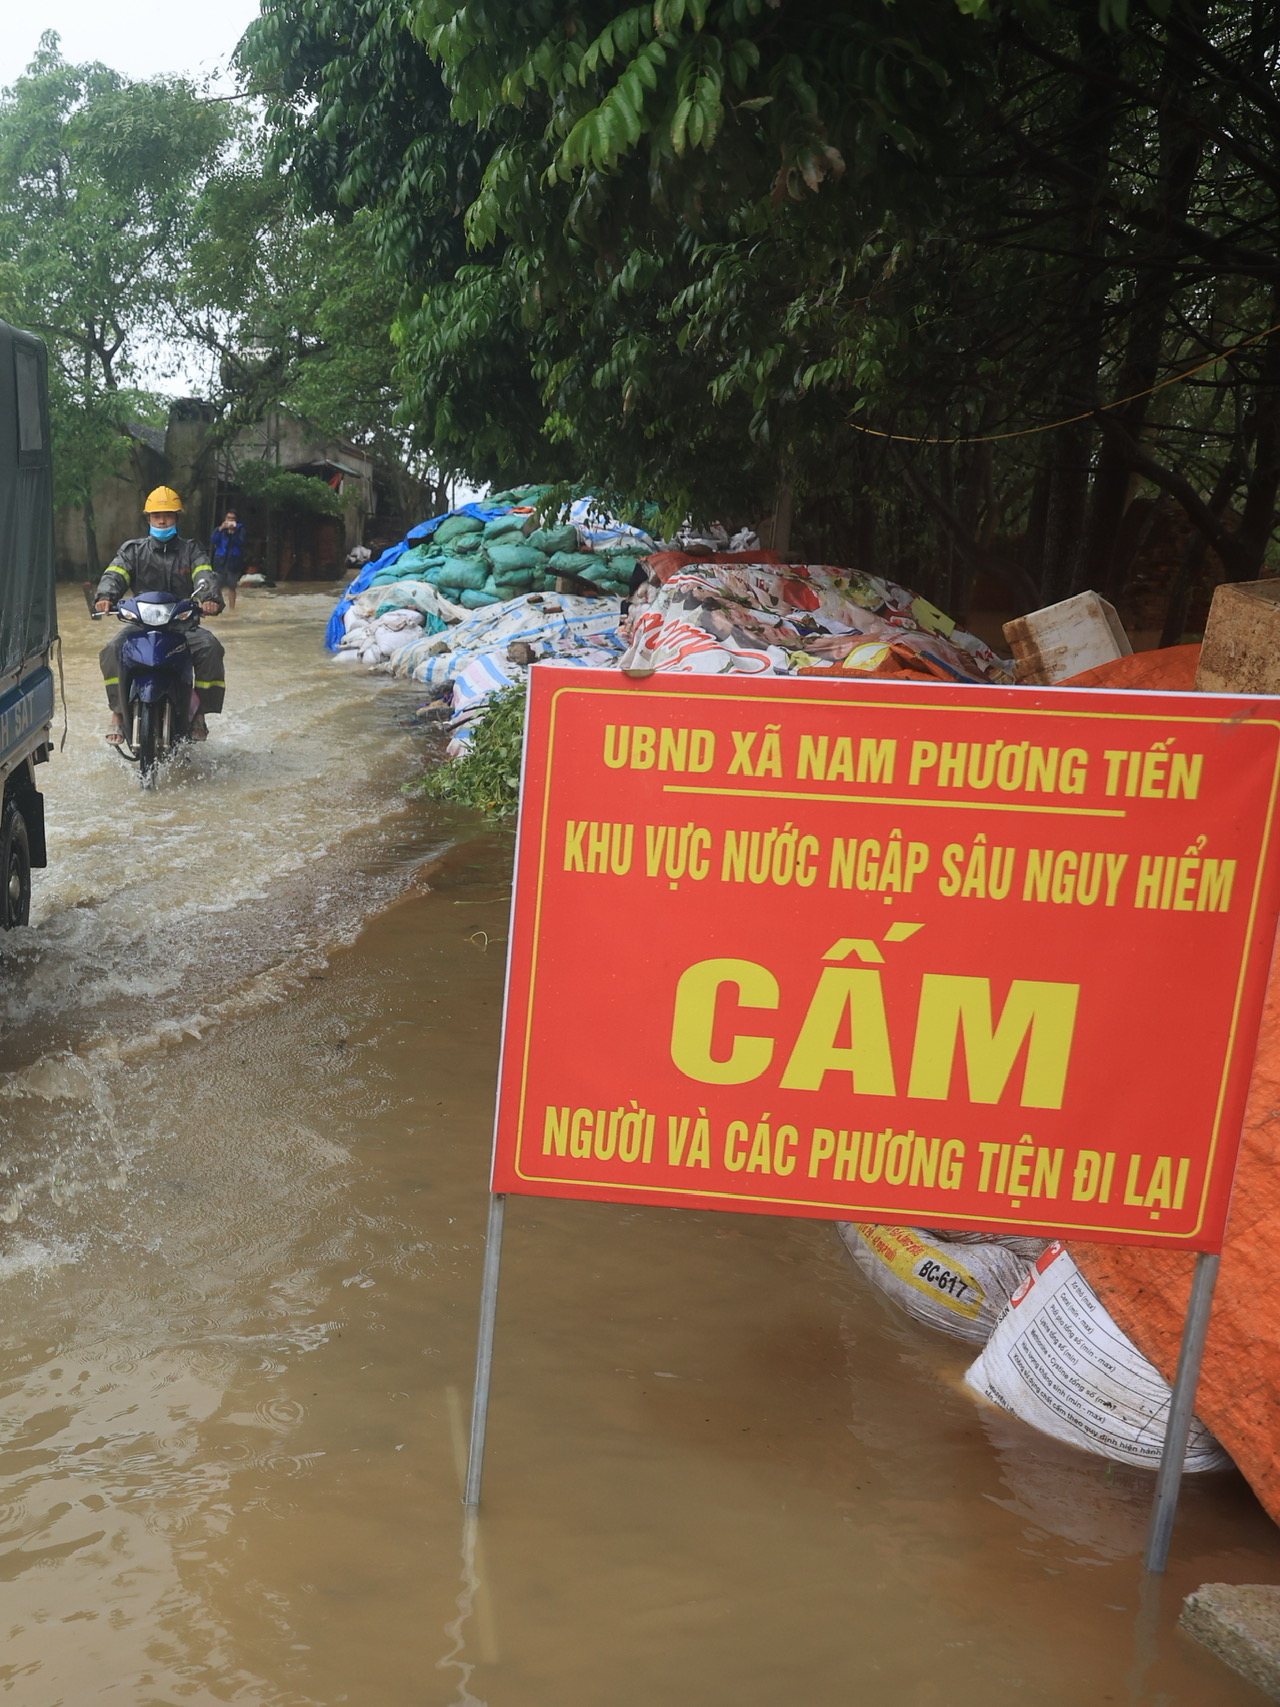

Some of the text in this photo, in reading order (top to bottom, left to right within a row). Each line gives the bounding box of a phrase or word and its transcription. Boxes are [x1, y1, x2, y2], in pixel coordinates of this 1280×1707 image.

[603, 723, 1203, 800] UBND XÃ NAM PHƯƠNG TIẾN
[563, 820, 1237, 913] KHU VỰC NƯỚC NGẬP SÂU NGUY HIỂM
[670, 921, 1080, 1110] CẤM
[542, 1099, 1190, 1220] NGƯỜI VÀ CÁC PHƯƠNG TIỆN ĐI LẠI
[918, 1260, 968, 1298] BC-617
[1081, 1296, 1096, 1312] (max)
[1080, 1319, 1094, 1334] max)
[1050, 1357, 1069, 1379] Cystine
[1063, 1349, 1078, 1365] (min)
[1080, 1343, 1094, 1357] (min
[1098, 1358, 1116, 1372] max)
[1053, 1384, 1066, 1397] sinh
[1066, 1394, 1082, 1408] (min
[1086, 1410, 1106, 1424] max)
[1067, 1412, 1083, 1427] theo
[1084, 1425, 1099, 1437] quy
[1099, 1434, 1118, 1446] định
[1119, 1441, 1138, 1452] hiện
[1140, 1446, 1161, 1455] hành
